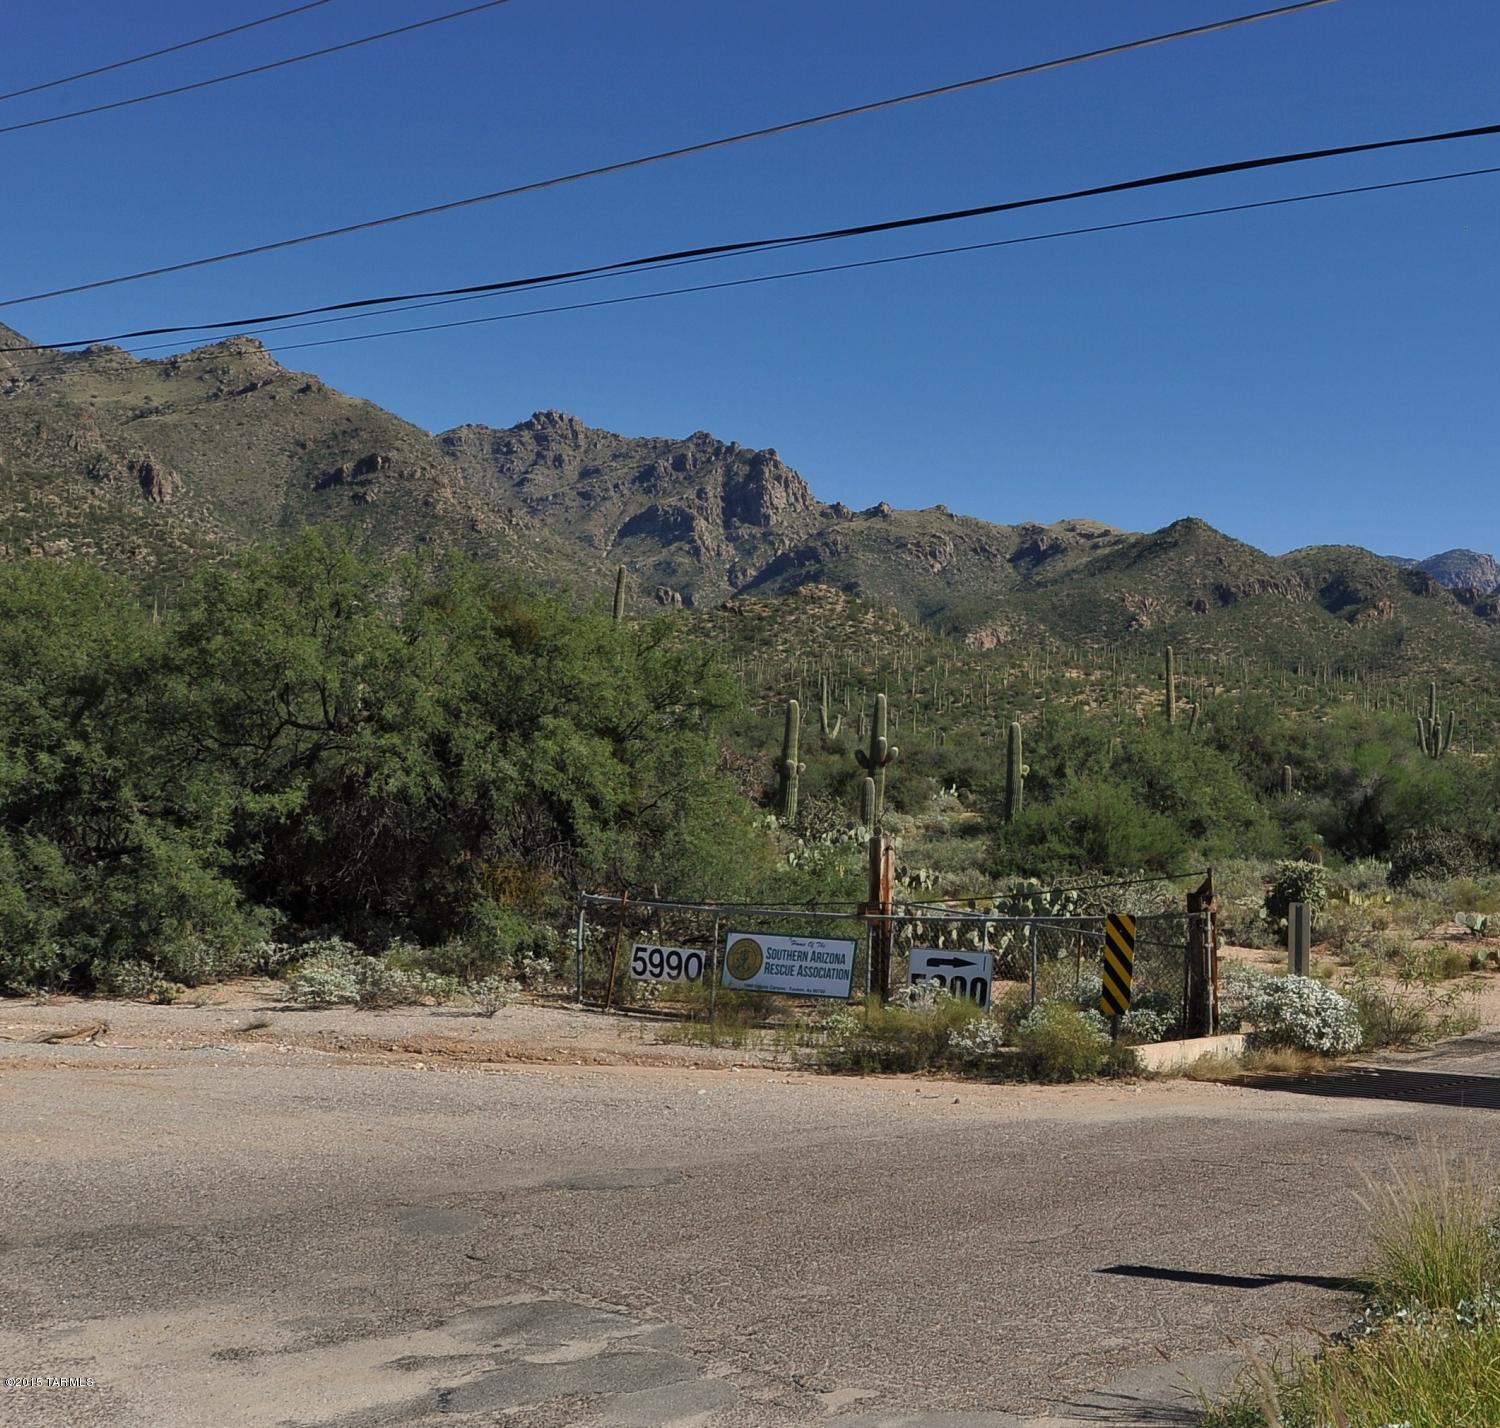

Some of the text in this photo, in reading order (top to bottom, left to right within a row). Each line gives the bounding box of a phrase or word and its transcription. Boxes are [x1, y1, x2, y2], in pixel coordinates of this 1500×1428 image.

[631, 946, 703, 982] 5990
[766, 947, 846, 965] SOUTHERN ARIZONA
[764, 962, 850, 980] RESCUE ASSOCIATION
